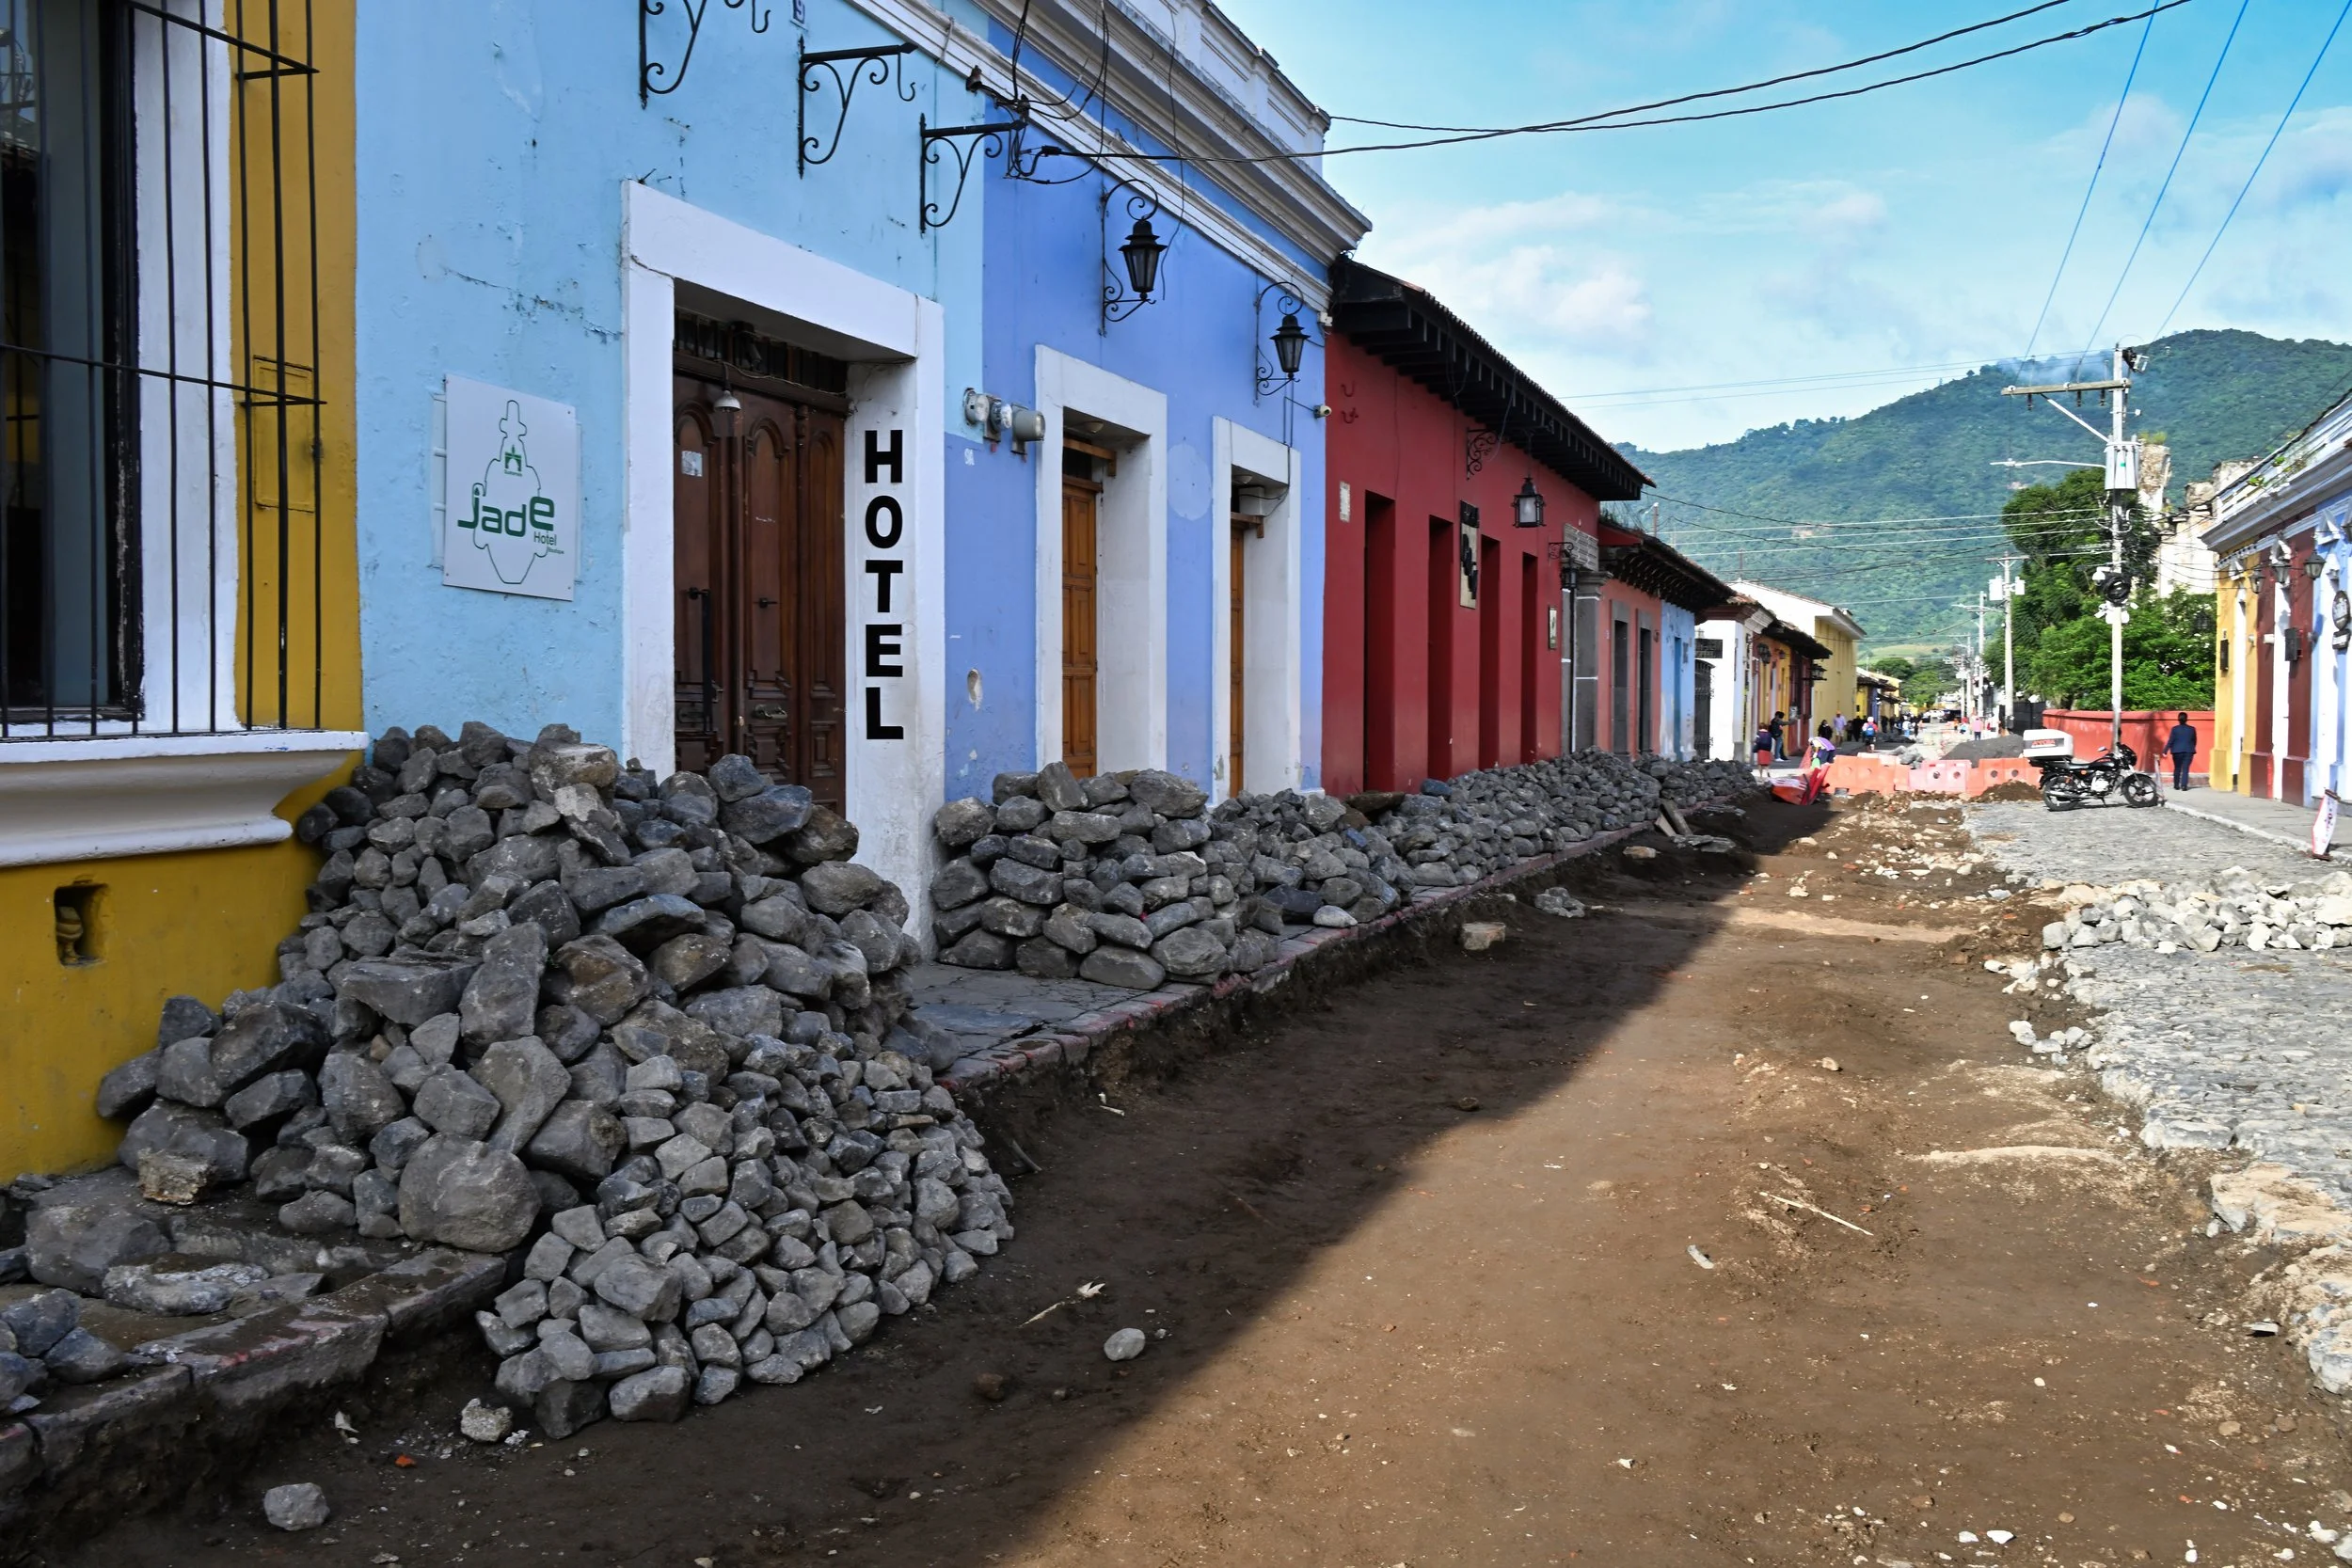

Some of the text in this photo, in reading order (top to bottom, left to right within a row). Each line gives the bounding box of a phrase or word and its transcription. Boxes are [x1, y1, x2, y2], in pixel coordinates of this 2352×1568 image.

[457, 487, 555, 537] jade
[533, 531, 557, 546] Hotel
[865, 430, 903, 740] HOTEL
